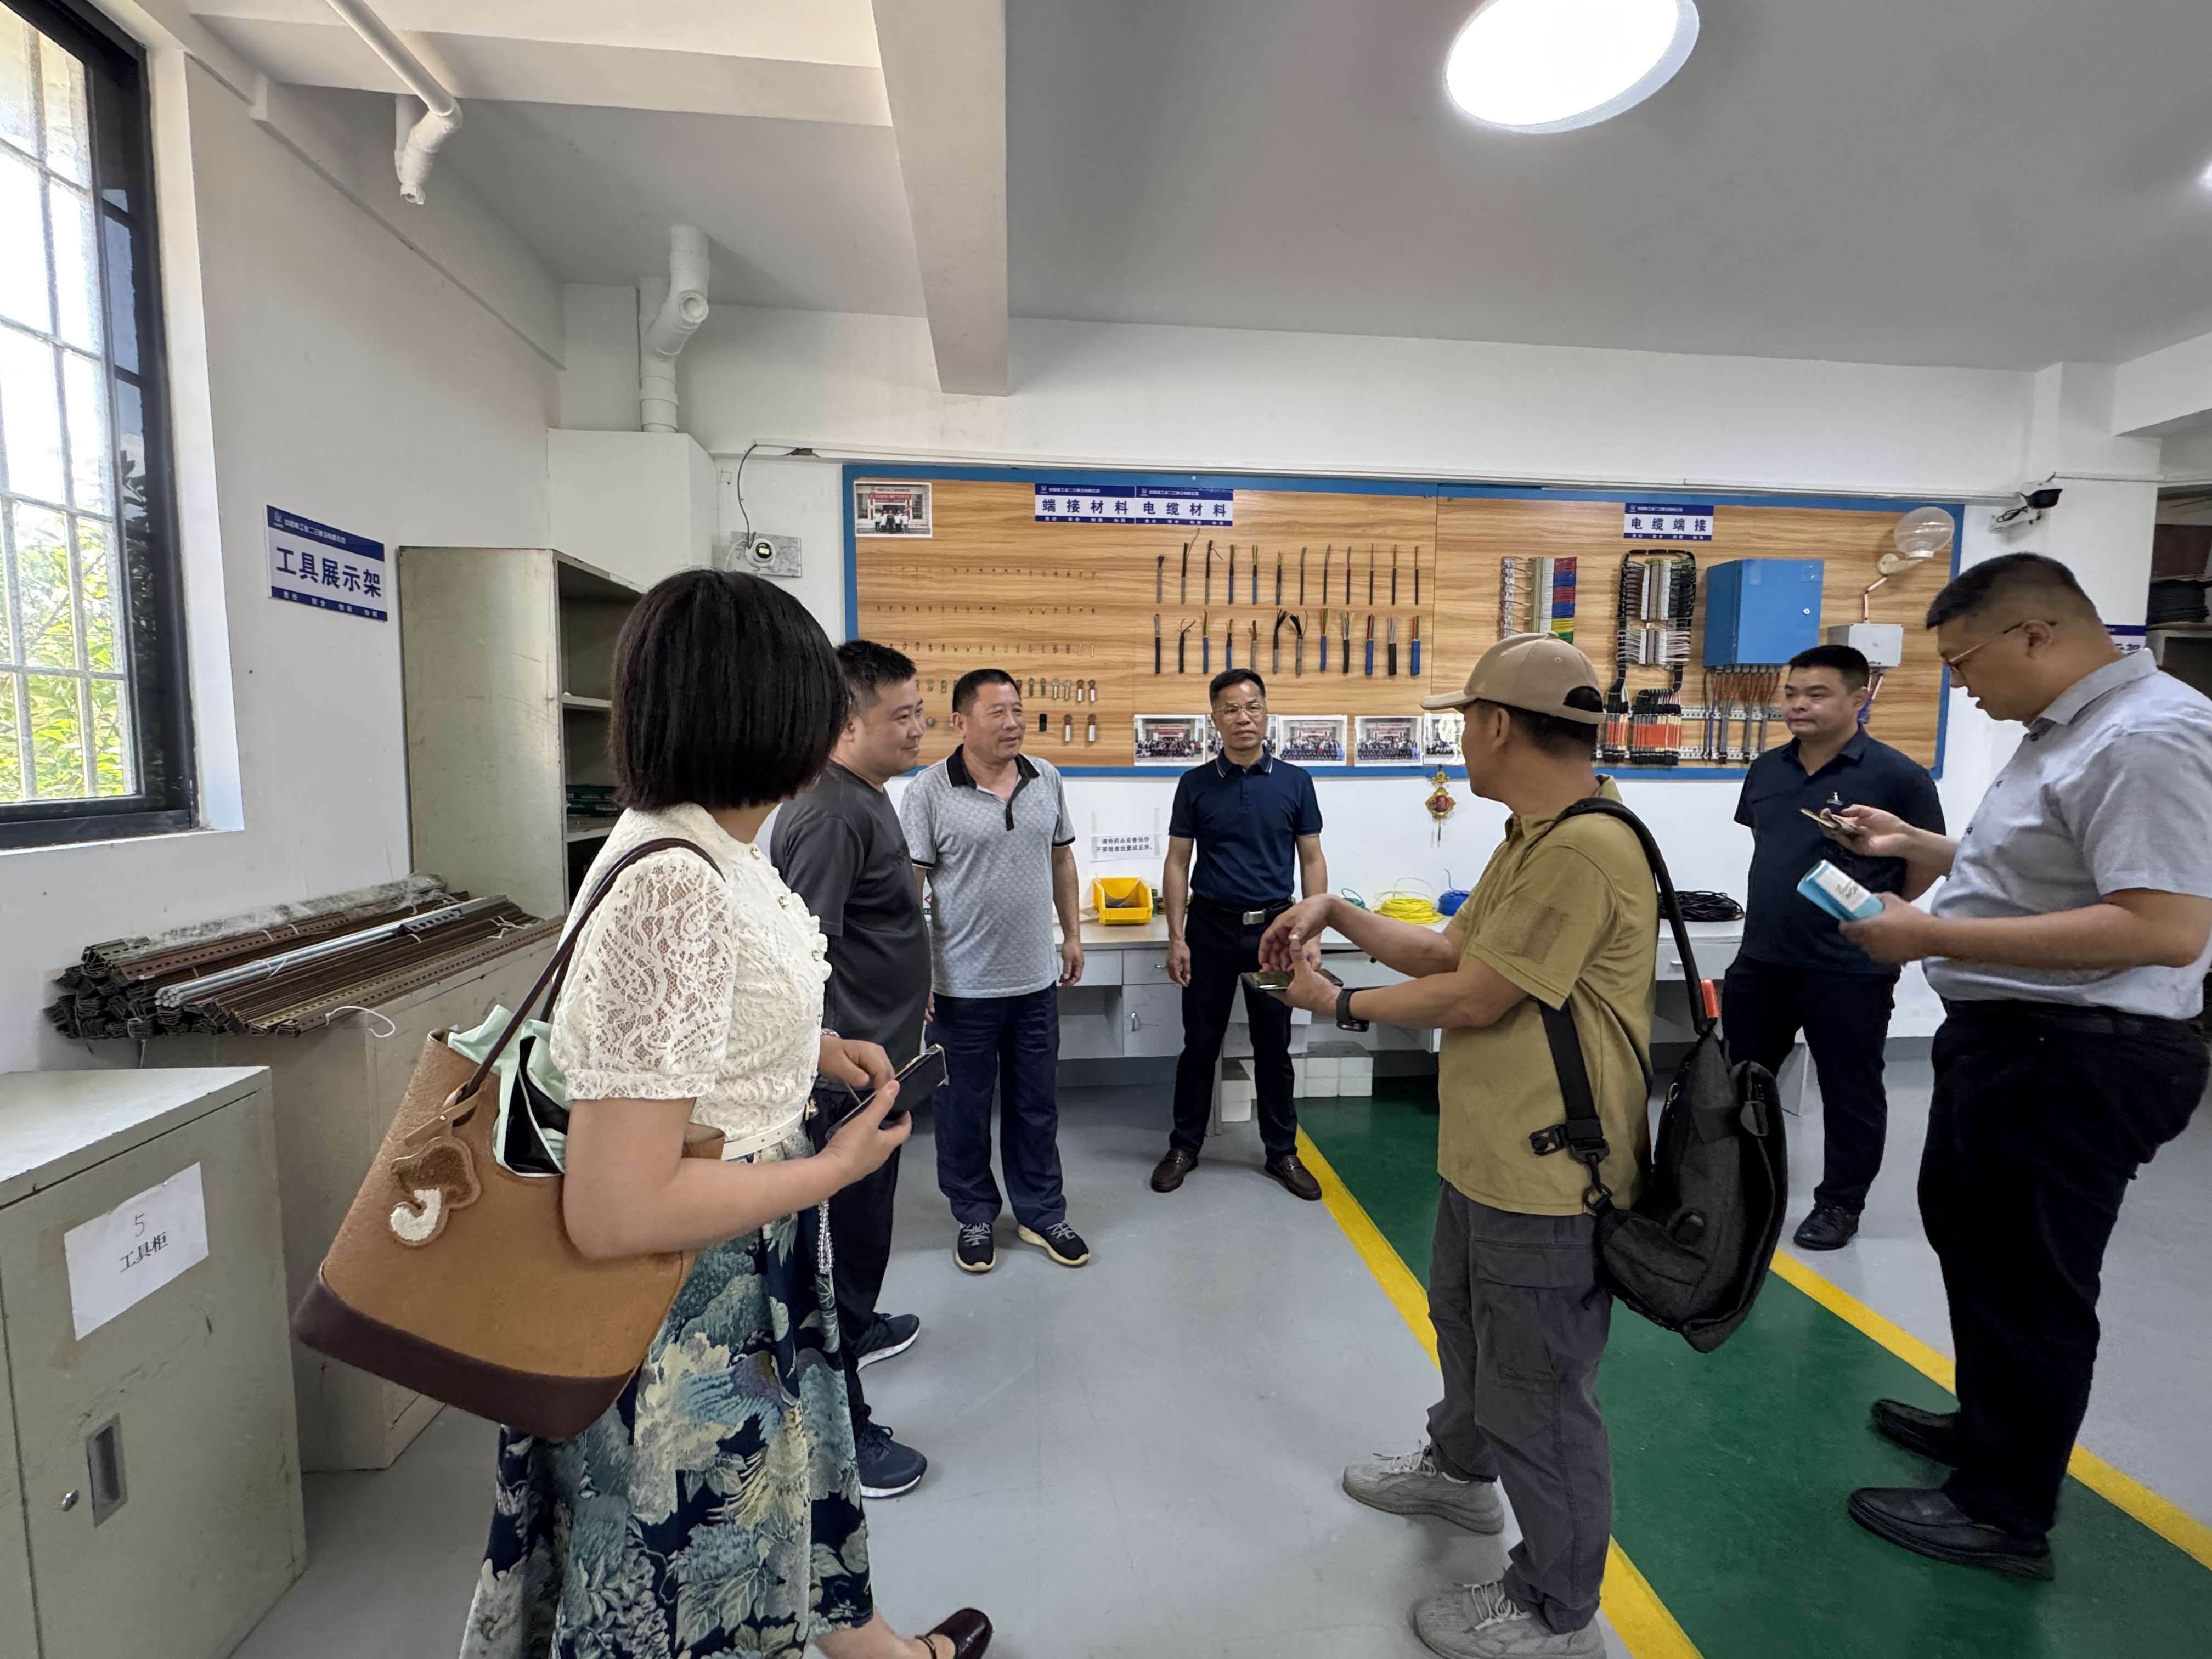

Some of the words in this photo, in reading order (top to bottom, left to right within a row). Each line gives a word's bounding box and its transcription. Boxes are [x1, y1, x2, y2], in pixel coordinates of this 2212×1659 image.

[1042, 498, 1128, 515] 端接材料
[1143, 501, 1226, 517] 电缆材料
[1631, 517, 1707, 532] 电缆端接
[276, 546, 382, 598] 工具展示架
[134, 1213, 145, 1237] 5
[120, 1231, 168, 1273] 工具柜
